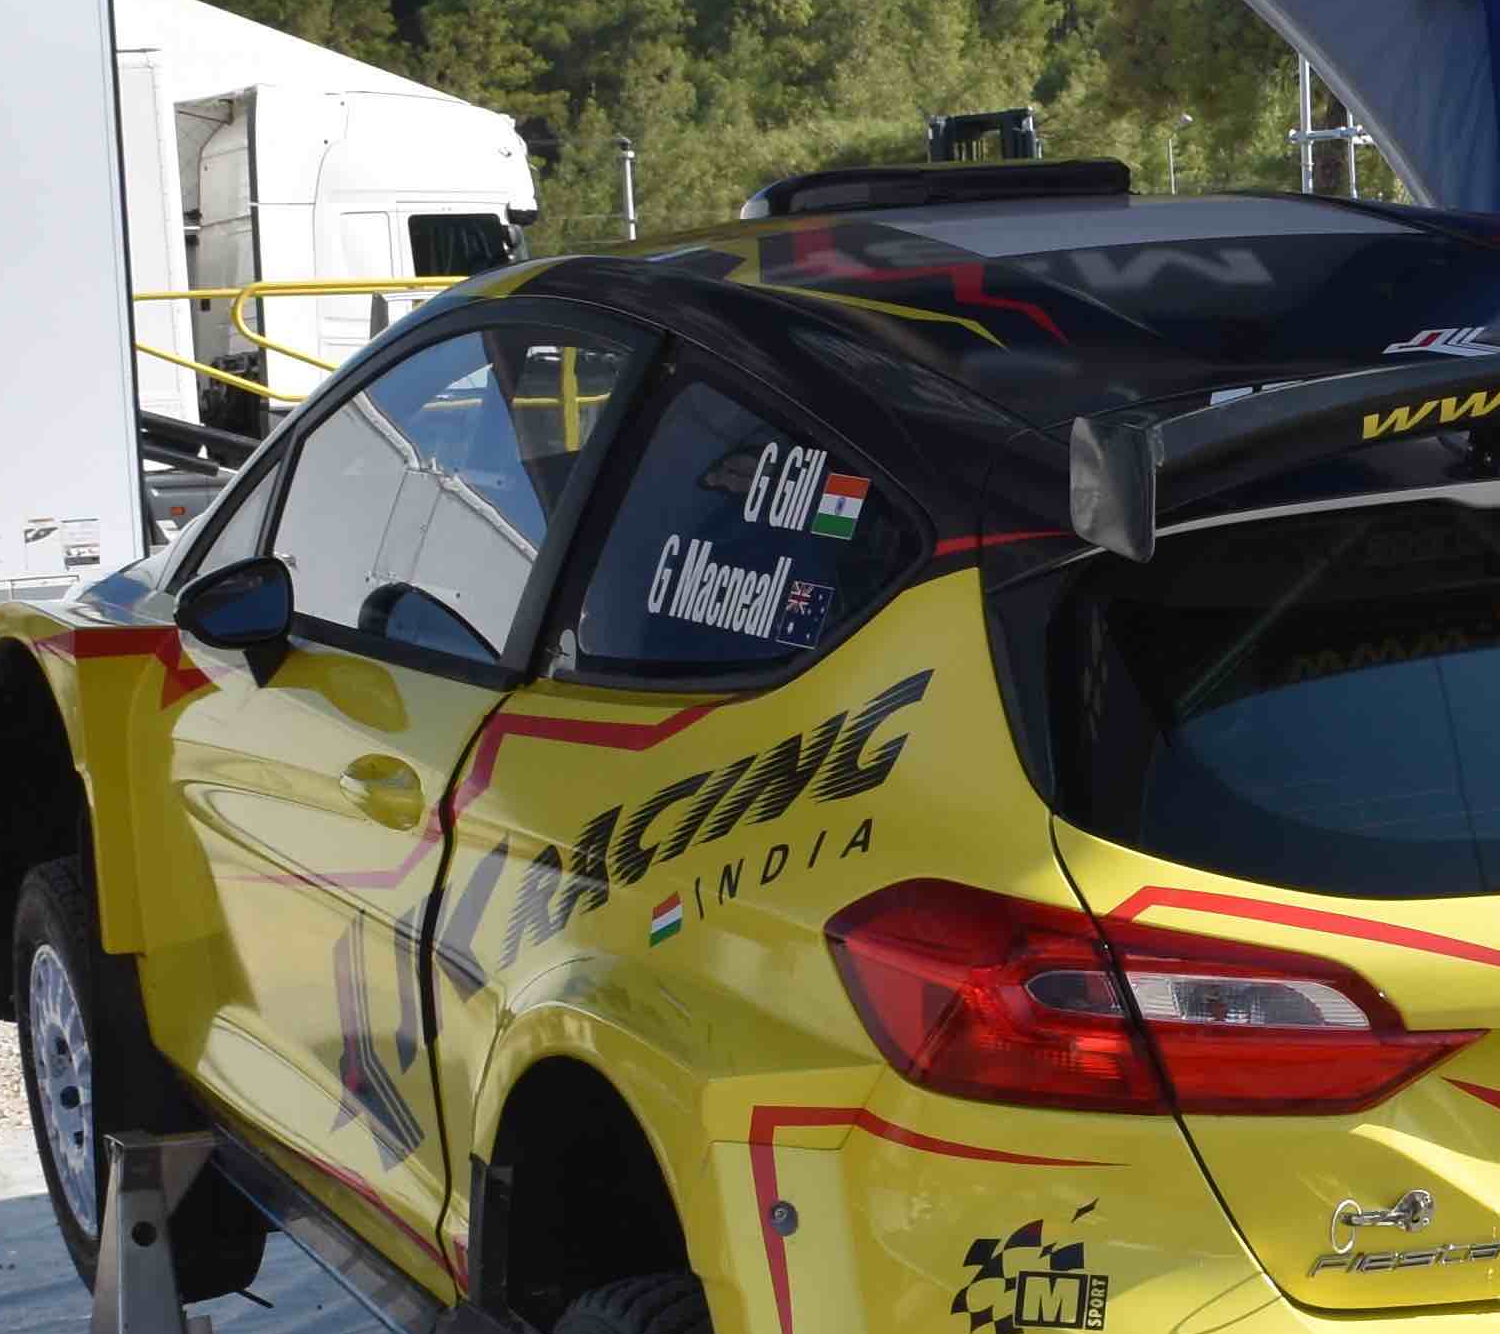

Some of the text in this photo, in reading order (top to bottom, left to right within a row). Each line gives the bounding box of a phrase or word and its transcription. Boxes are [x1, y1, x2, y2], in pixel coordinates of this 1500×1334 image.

[744, 442, 828, 532] G Gill
[647, 533, 793, 640] G Macneall
[500, 668, 935, 971] RACING
[693, 817, 875, 920] INDIA
[1021, 1276, 1081, 1324] M
[1087, 1277, 1107, 1328] SPORT
